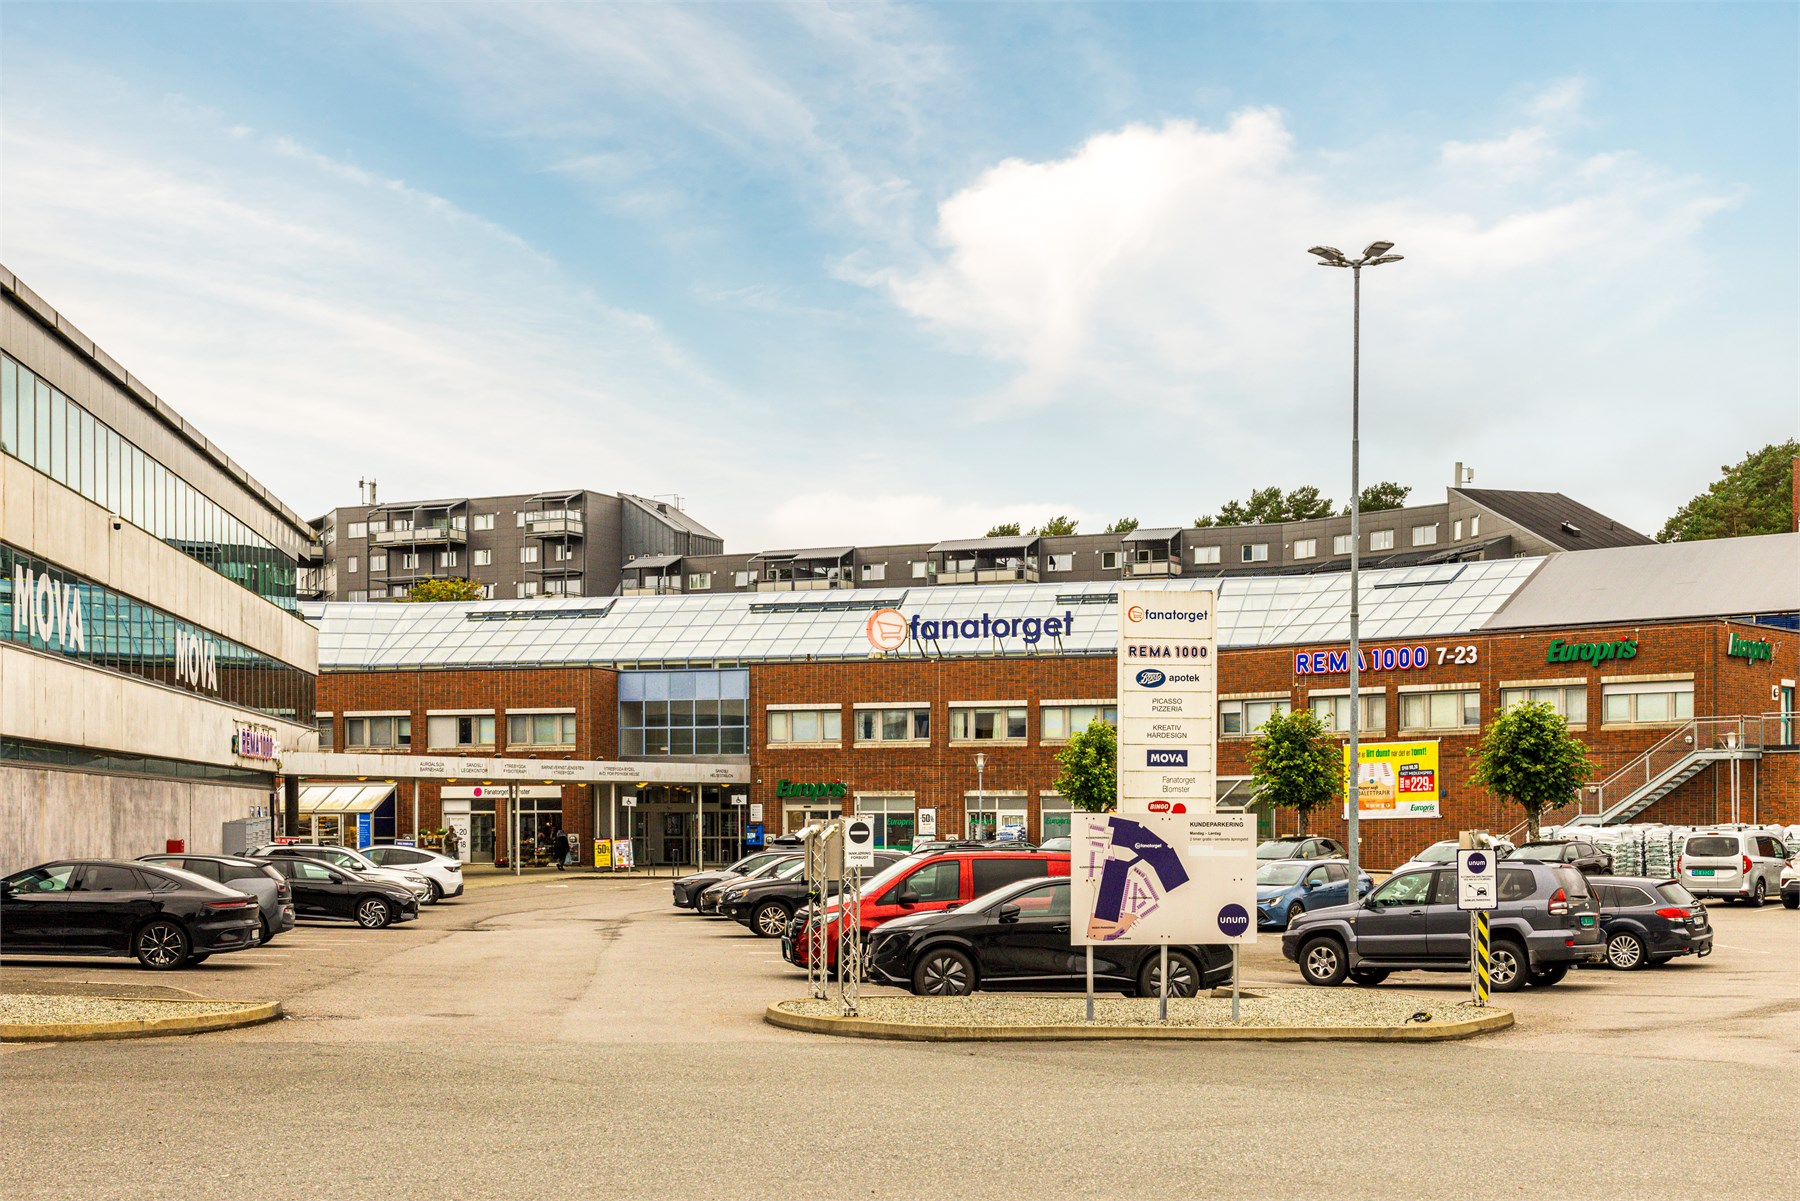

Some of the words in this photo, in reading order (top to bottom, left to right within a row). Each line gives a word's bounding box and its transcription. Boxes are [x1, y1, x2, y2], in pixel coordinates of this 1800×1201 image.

[14, 564, 85, 651] MOVA
[1145, 609, 1208, 622] fanatorget
[911, 611, 1073, 644] fanatorget
[1128, 646, 1171, 658] REMA
[1174, 646, 1208, 658] 1000
[1546, 636, 1638, 667] Europris
[1728, 632, 1772, 665] Europris
[176, 628, 218, 692] MOVA
[1371, 646, 1428, 671] 1000
[1436, 646, 1477, 665] 7-23
[1168, 674, 1200, 683] apotek
[1150, 753, 1184, 763] MOVA
[1162, 776, 1196, 785] Fanatorget
[484, 788, 509, 796] Fanatorget
[776, 778, 847, 801] Europris
[1149, 803, 1170, 811] BINGO
[1410, 804, 1435, 813] Europris
[886, 816, 914, 827] Europris
[1220, 916, 1247, 924] unum
